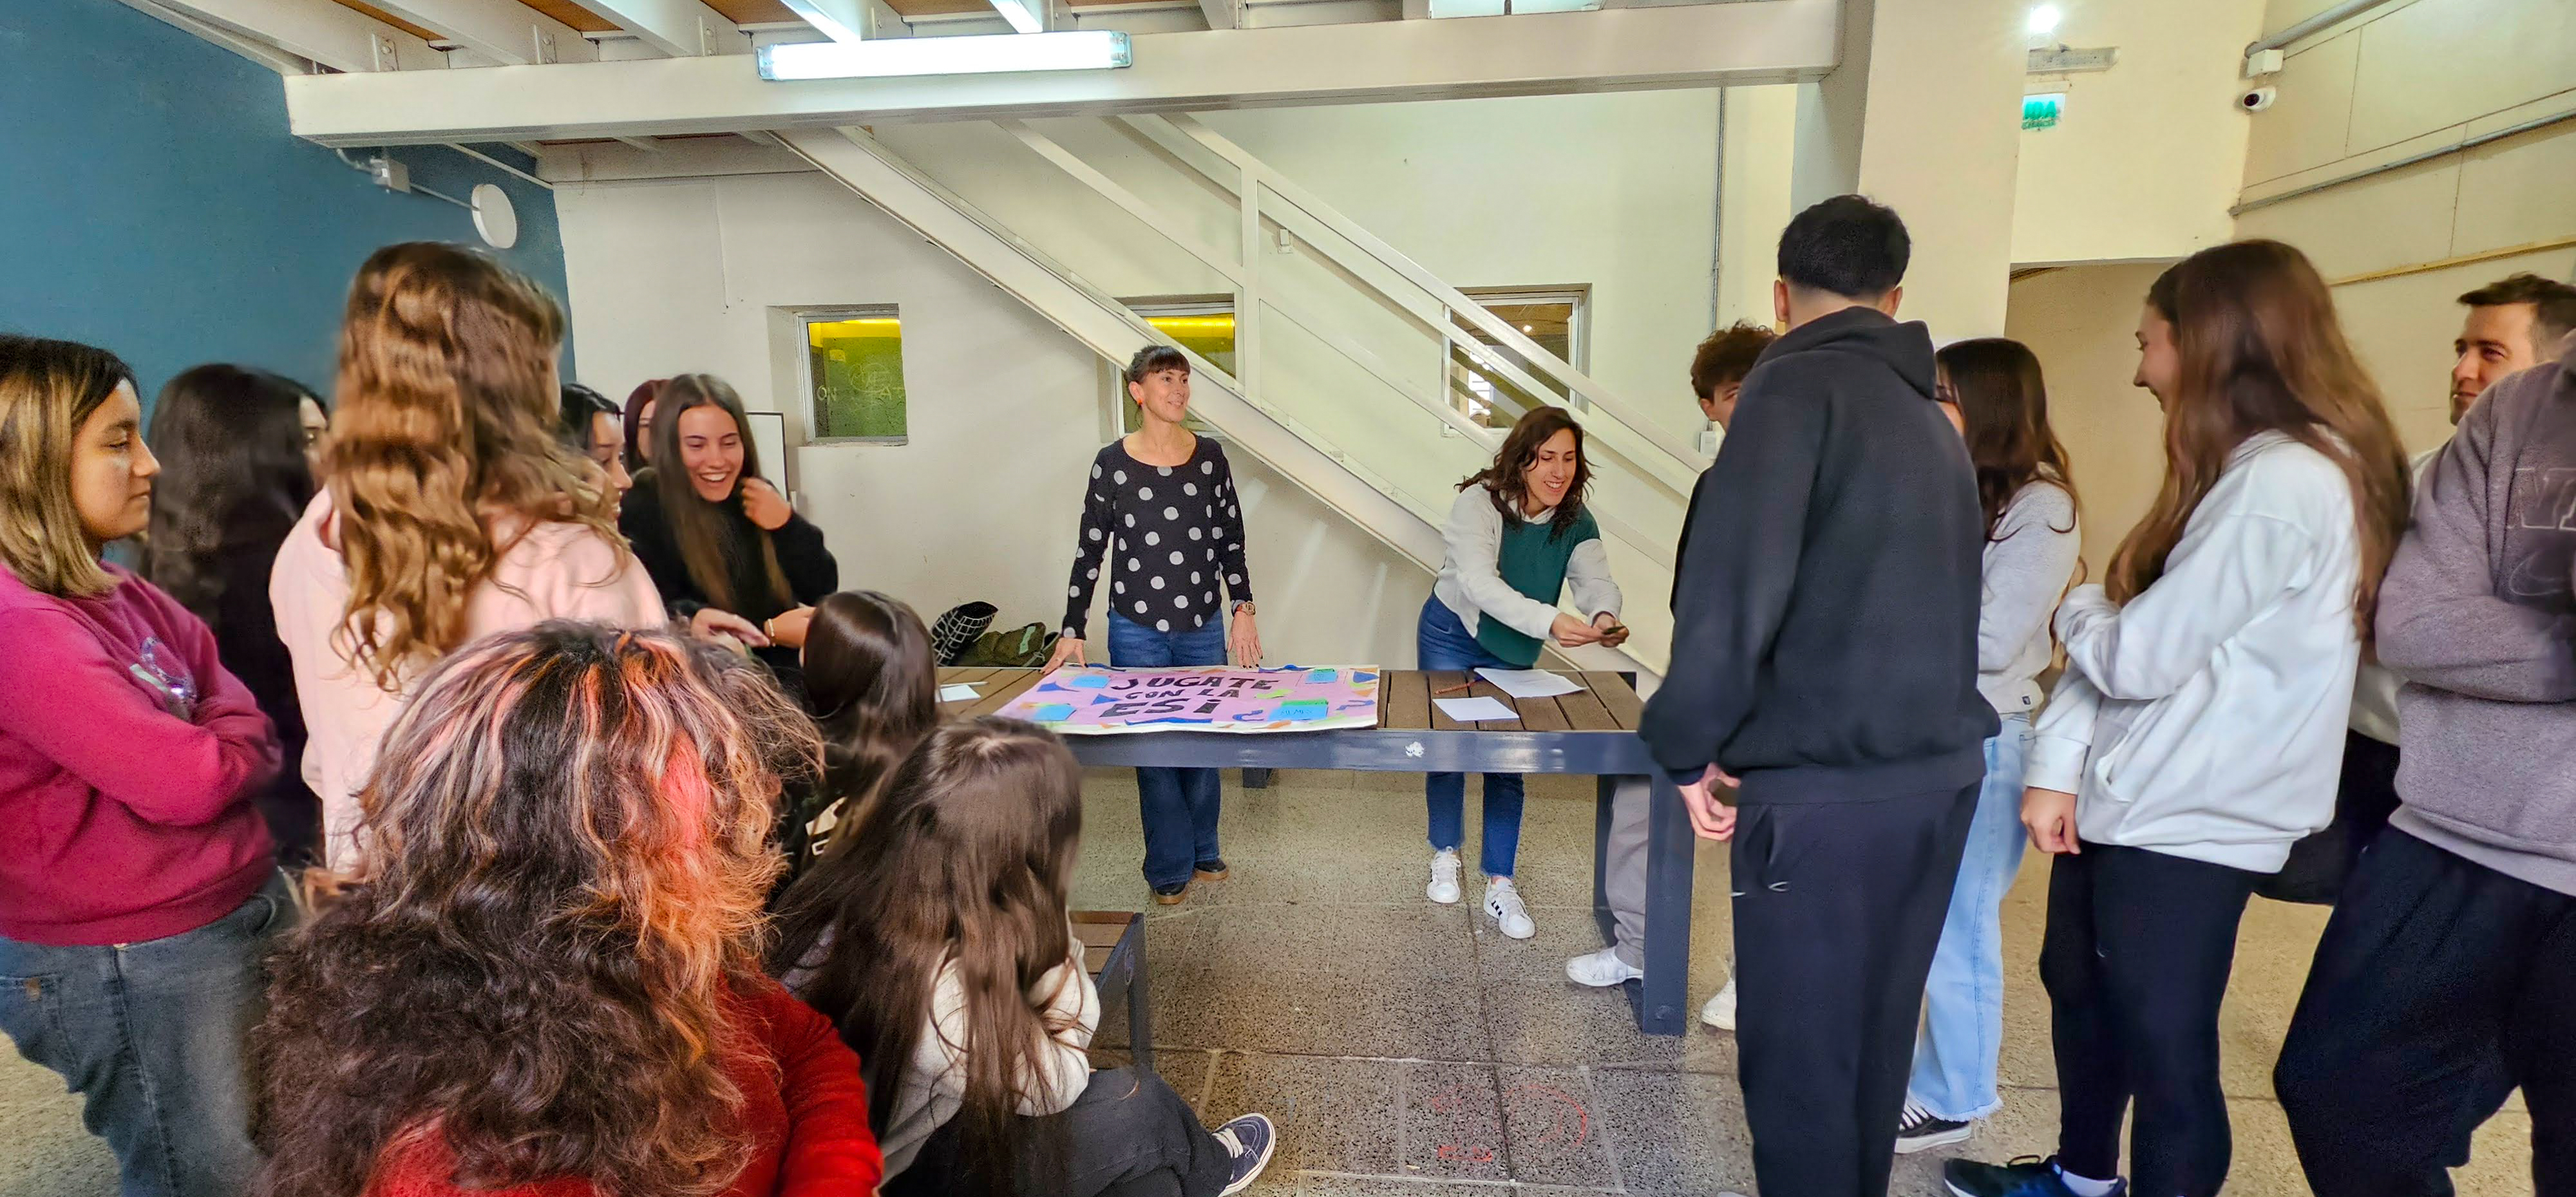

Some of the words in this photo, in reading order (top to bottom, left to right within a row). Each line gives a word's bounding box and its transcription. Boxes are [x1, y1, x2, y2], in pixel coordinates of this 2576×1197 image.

[1111, 676, 1281, 690] JUGATE
[1125, 689, 1185, 700] CON
[1197, 688, 1240, 698] LA
